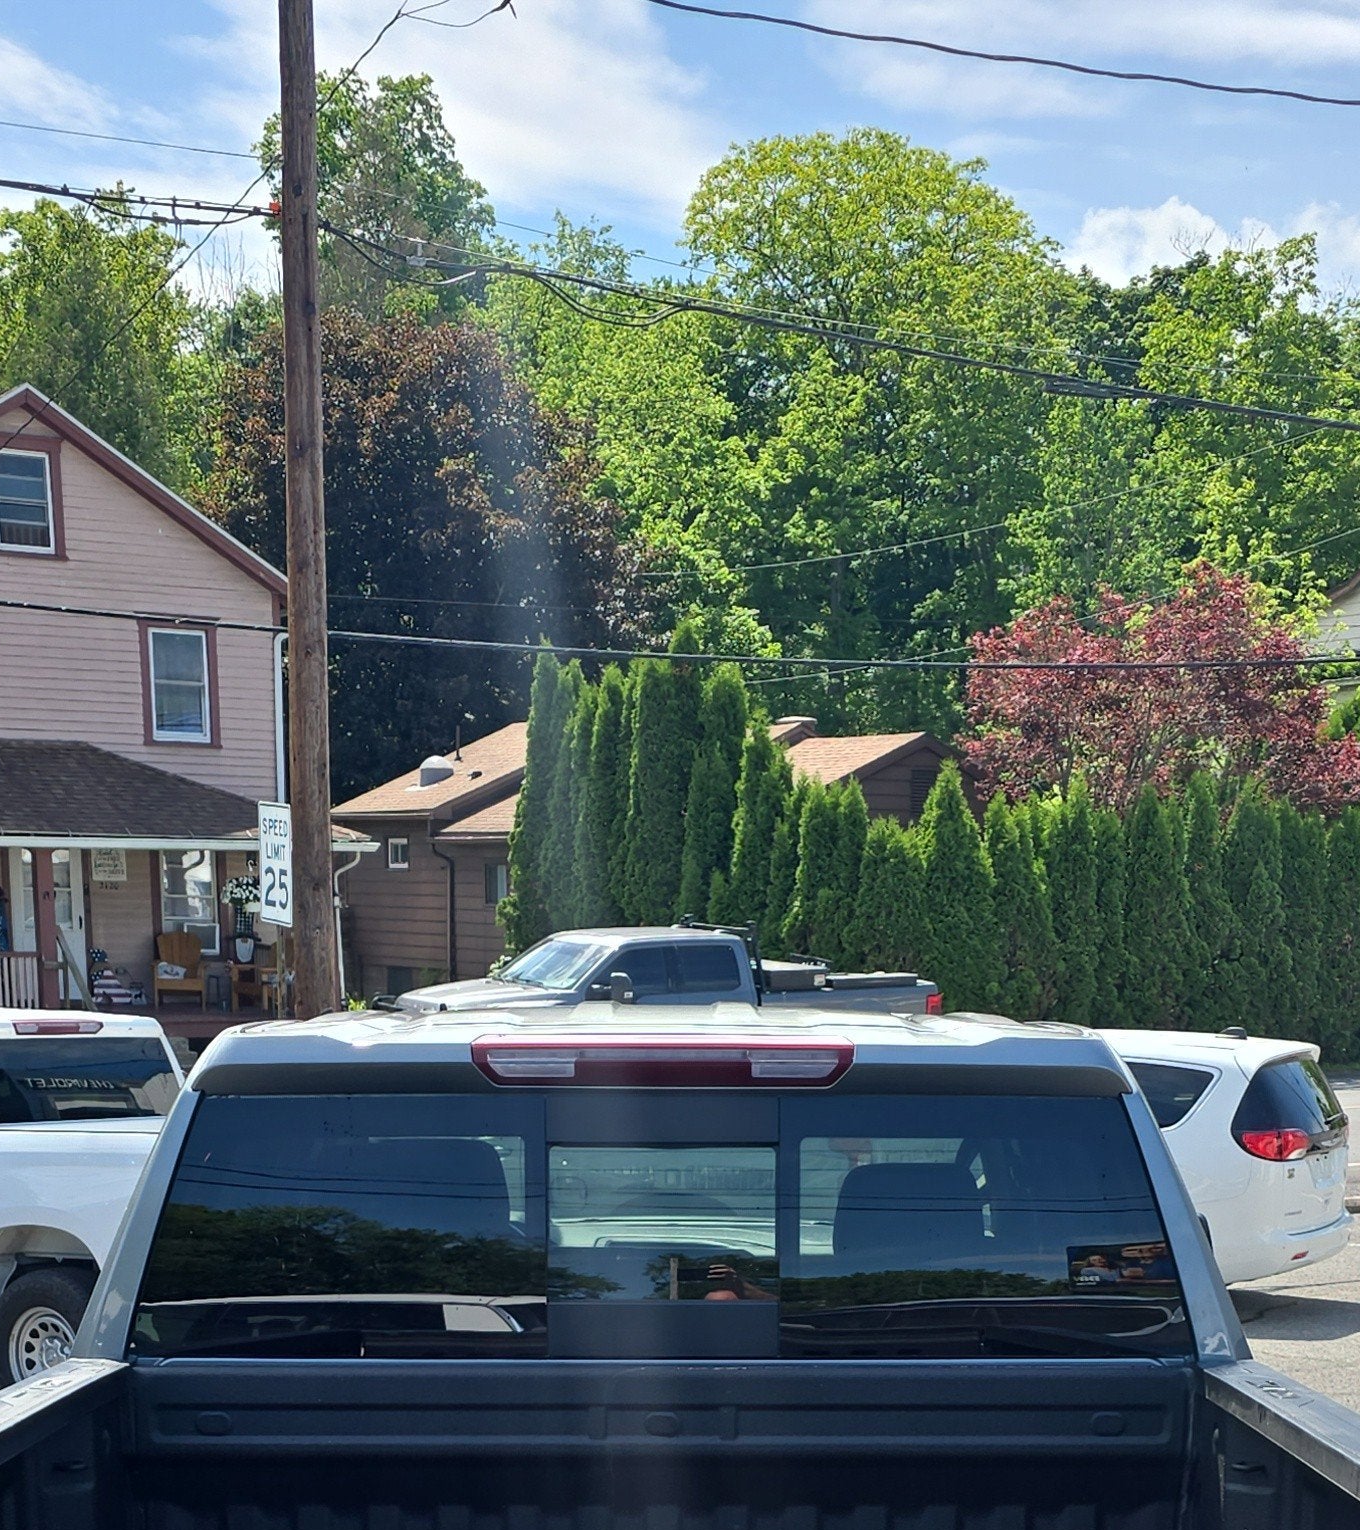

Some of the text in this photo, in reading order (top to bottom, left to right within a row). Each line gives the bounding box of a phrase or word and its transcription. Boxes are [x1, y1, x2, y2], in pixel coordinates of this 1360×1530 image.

[262, 817, 288, 838] SPEED
[265, 843, 286, 862] LIMIT
[264, 865, 289, 910] 25
